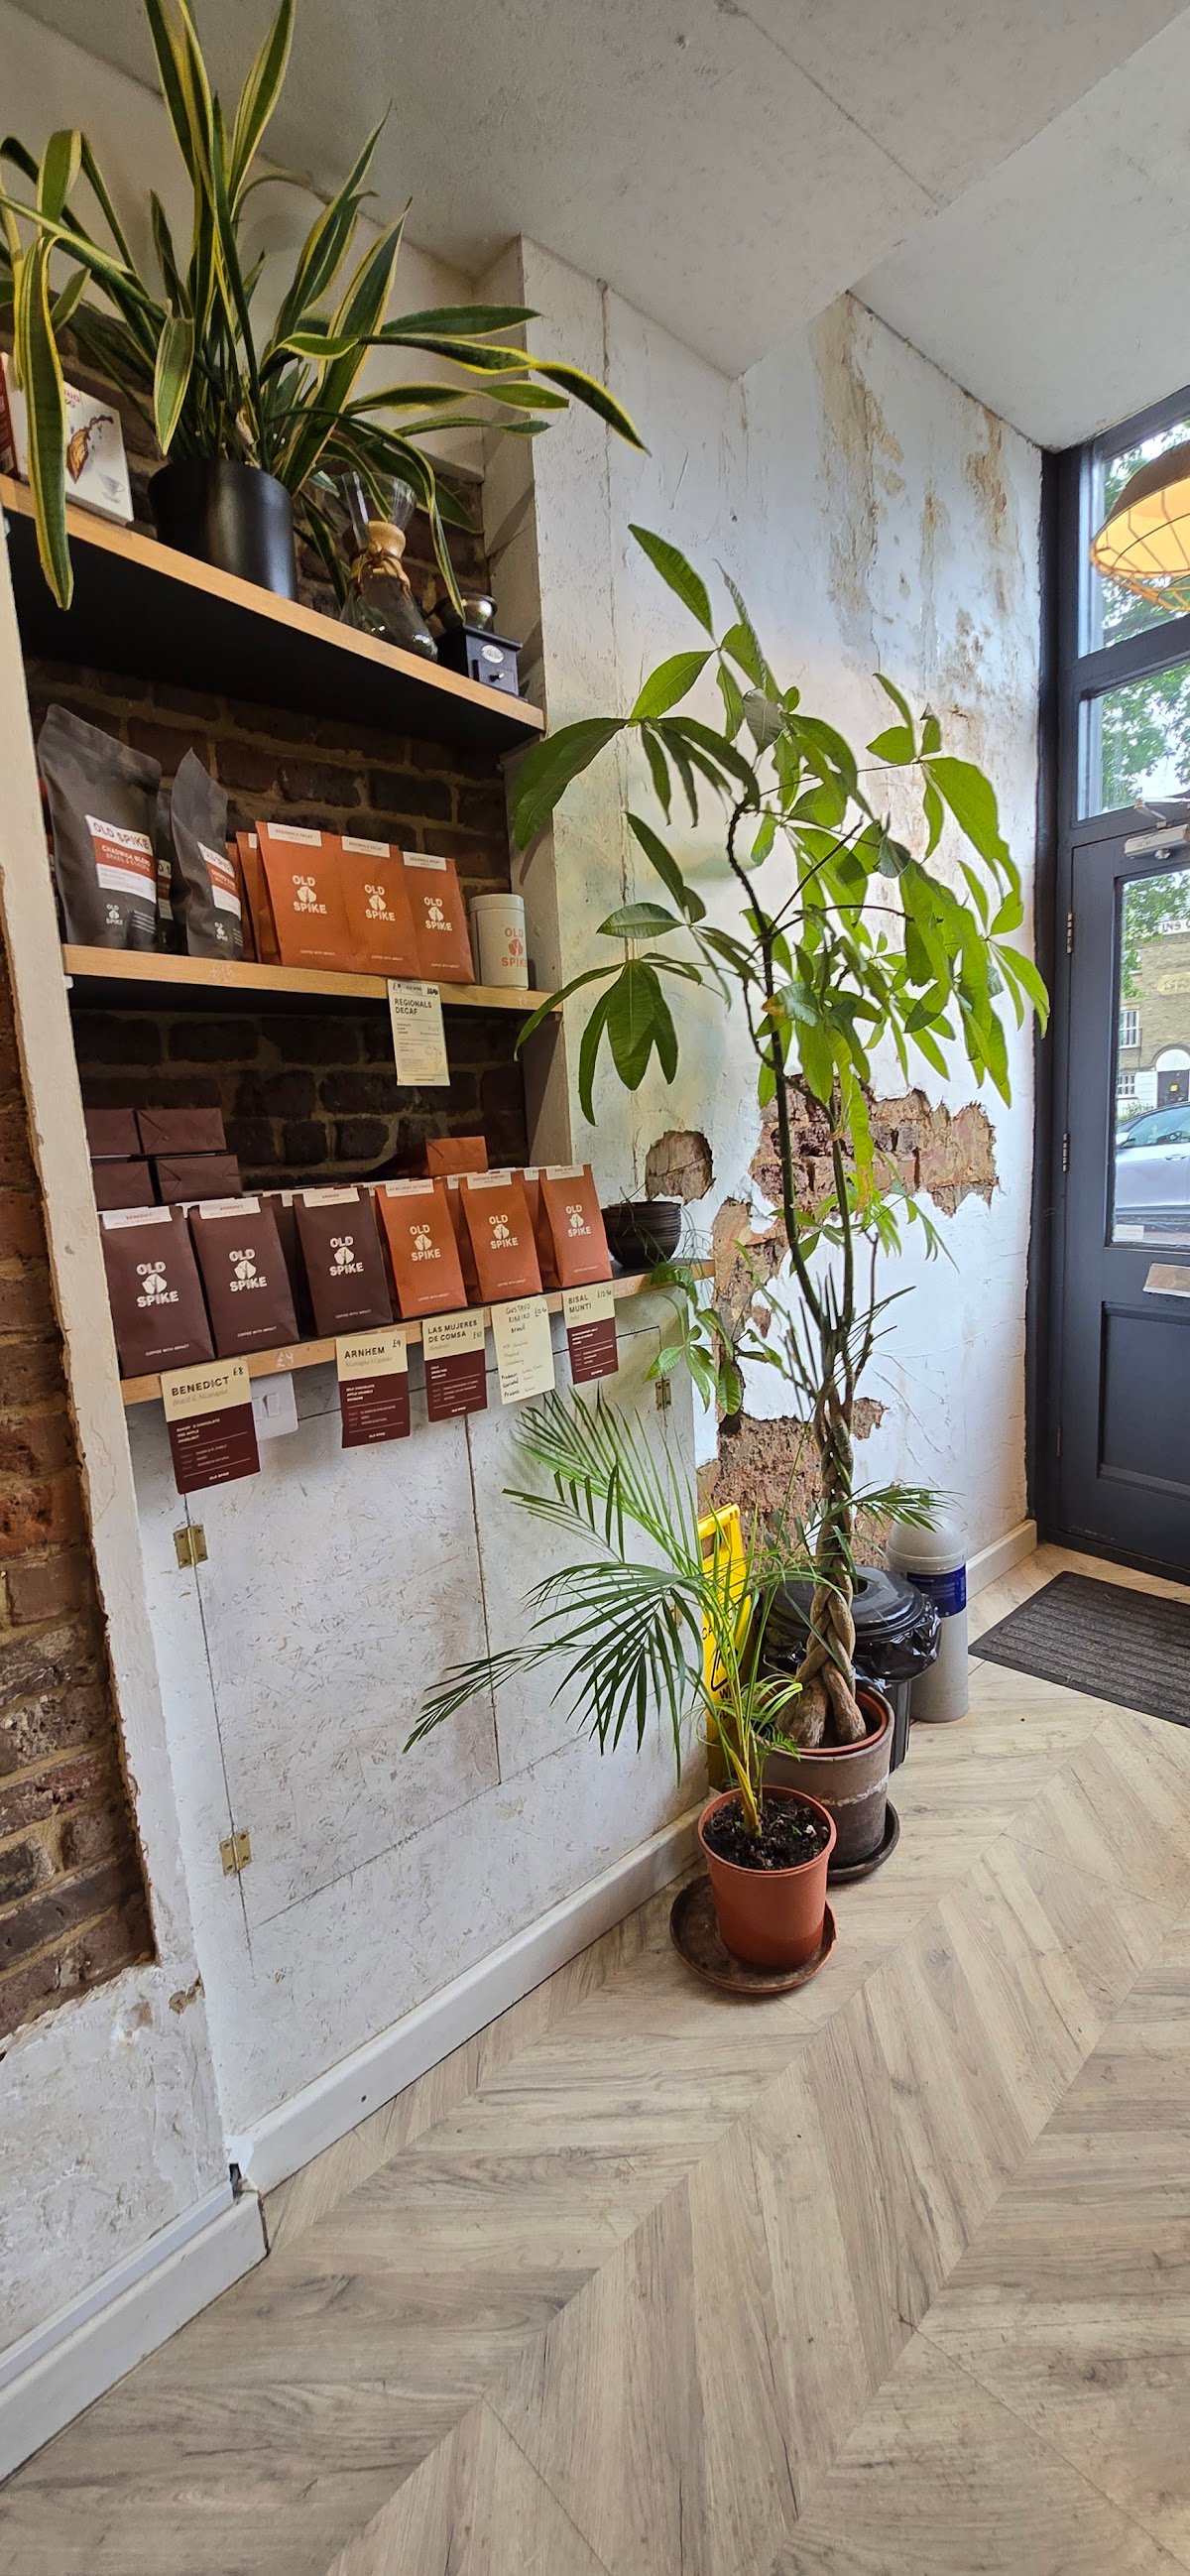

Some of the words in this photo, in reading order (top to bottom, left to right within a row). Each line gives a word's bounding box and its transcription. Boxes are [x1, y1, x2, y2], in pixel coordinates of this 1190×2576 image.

[93, 822, 115, 837] OLD
[117, 832, 149, 850] SPIKE
[292, 875, 315, 887] OLD
[365, 884, 385, 895] OLD
[424, 897, 442, 907] OLD
[294, 902, 327, 915] SPIKE
[365, 909, 396, 921] SPIKE
[425, 920, 452, 931] SPIKE
[505, 927, 524, 938] OLD
[395, 998, 432, 1008] REGIONALS
[396, 1007, 417, 1016] DECAF
[565, 1205, 582, 1214] OLD
[489, 1214, 508, 1224] OLD
[410, 1224, 430, 1236] OLD
[567, 1226, 591, 1237] SPIKE
[329, 1236, 353, 1248] OLD
[490, 1237, 519, 1250] SPIKE
[229, 1249, 256, 1262] OLD
[412, 1248, 441, 1262] SPIKE
[136, 1262, 167, 1276] OLD
[329, 1262, 364, 1277] SPIKE
[229, 1276, 268, 1292] SPIKE
[137, 1290, 178, 1308] SPIKE
[568, 1294, 589, 1304] BISAL
[506, 1303, 531, 1314] GUSTAVO
[569, 1302, 592, 1313] MUNTI
[509, 1313, 530, 1323] RIBEIRO
[444, 1320, 477, 1332] MUJERES
[440, 1331, 466, 1341] COMSA
[392, 1339, 401, 1348] £9
[344, 1346, 385, 1359] ARNHEM
[233, 1367, 244, 1376] £8
[172, 1376, 229, 1397] BENEDICT
